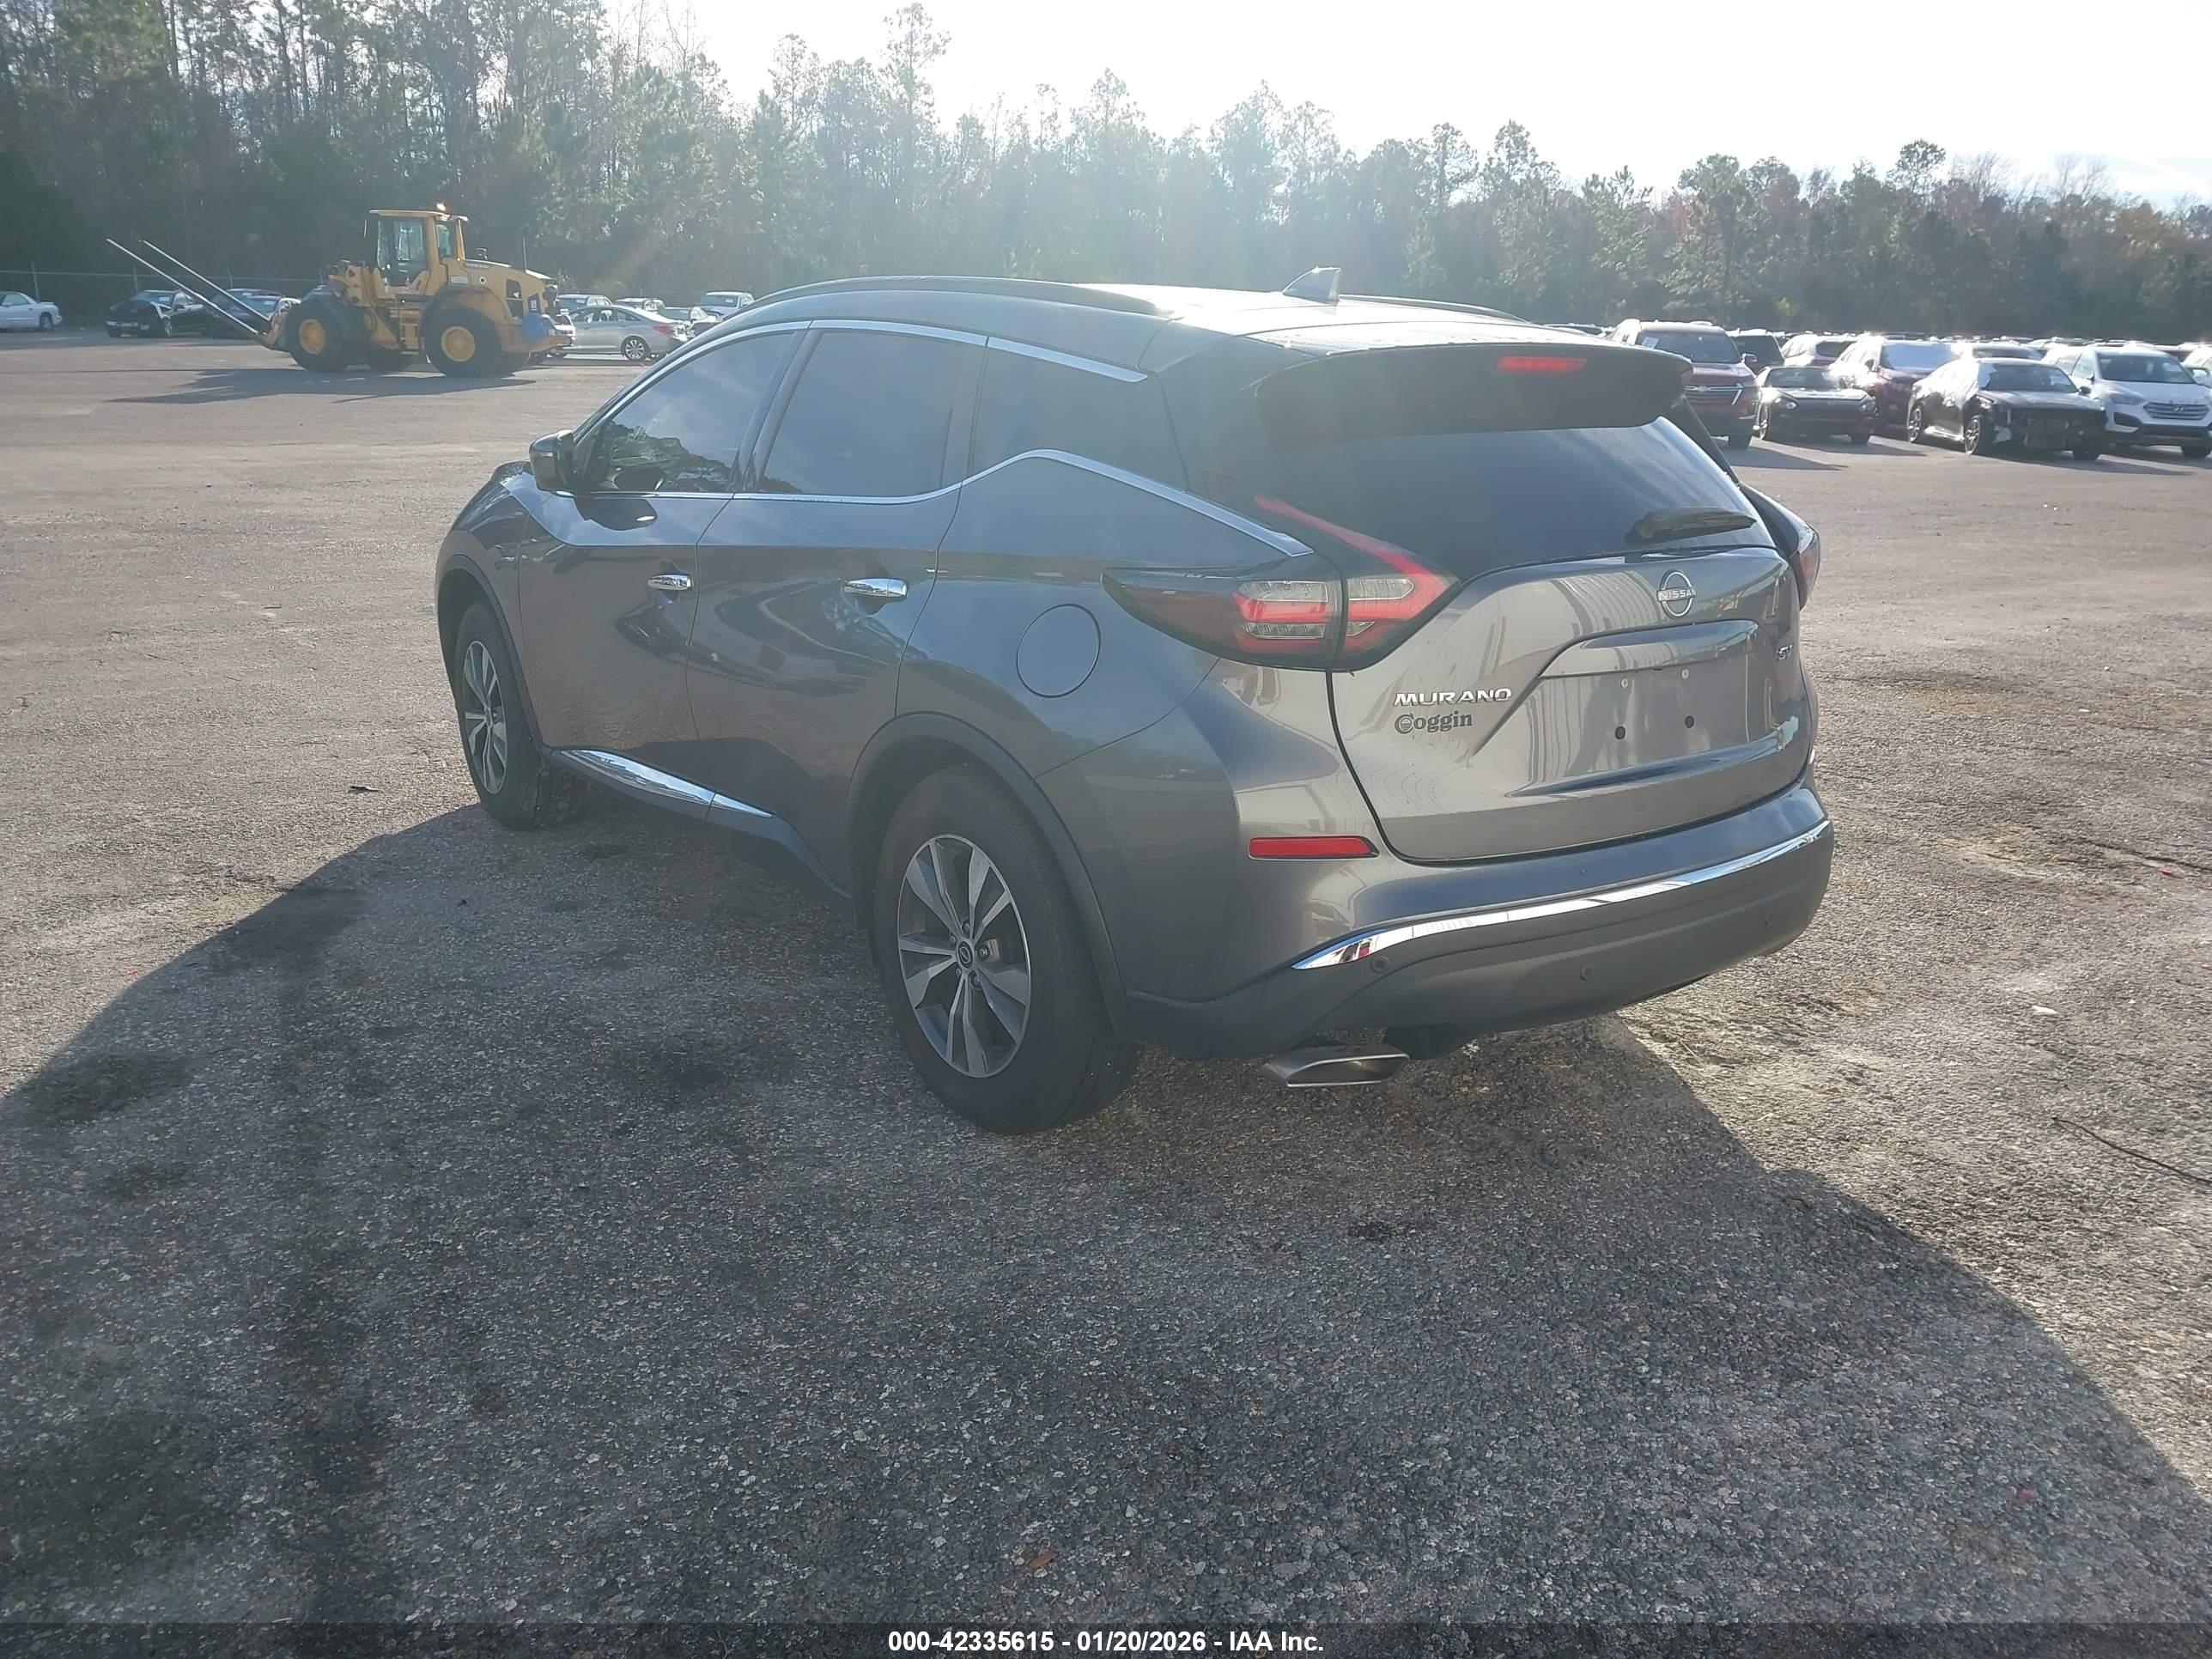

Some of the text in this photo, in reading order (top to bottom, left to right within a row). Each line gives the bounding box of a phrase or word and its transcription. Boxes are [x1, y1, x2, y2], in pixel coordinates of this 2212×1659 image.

[1658, 589, 1696, 600] NISSAN
[1394, 688, 1511, 706] MURANO
[1394, 710, 1473, 734] Coggin
